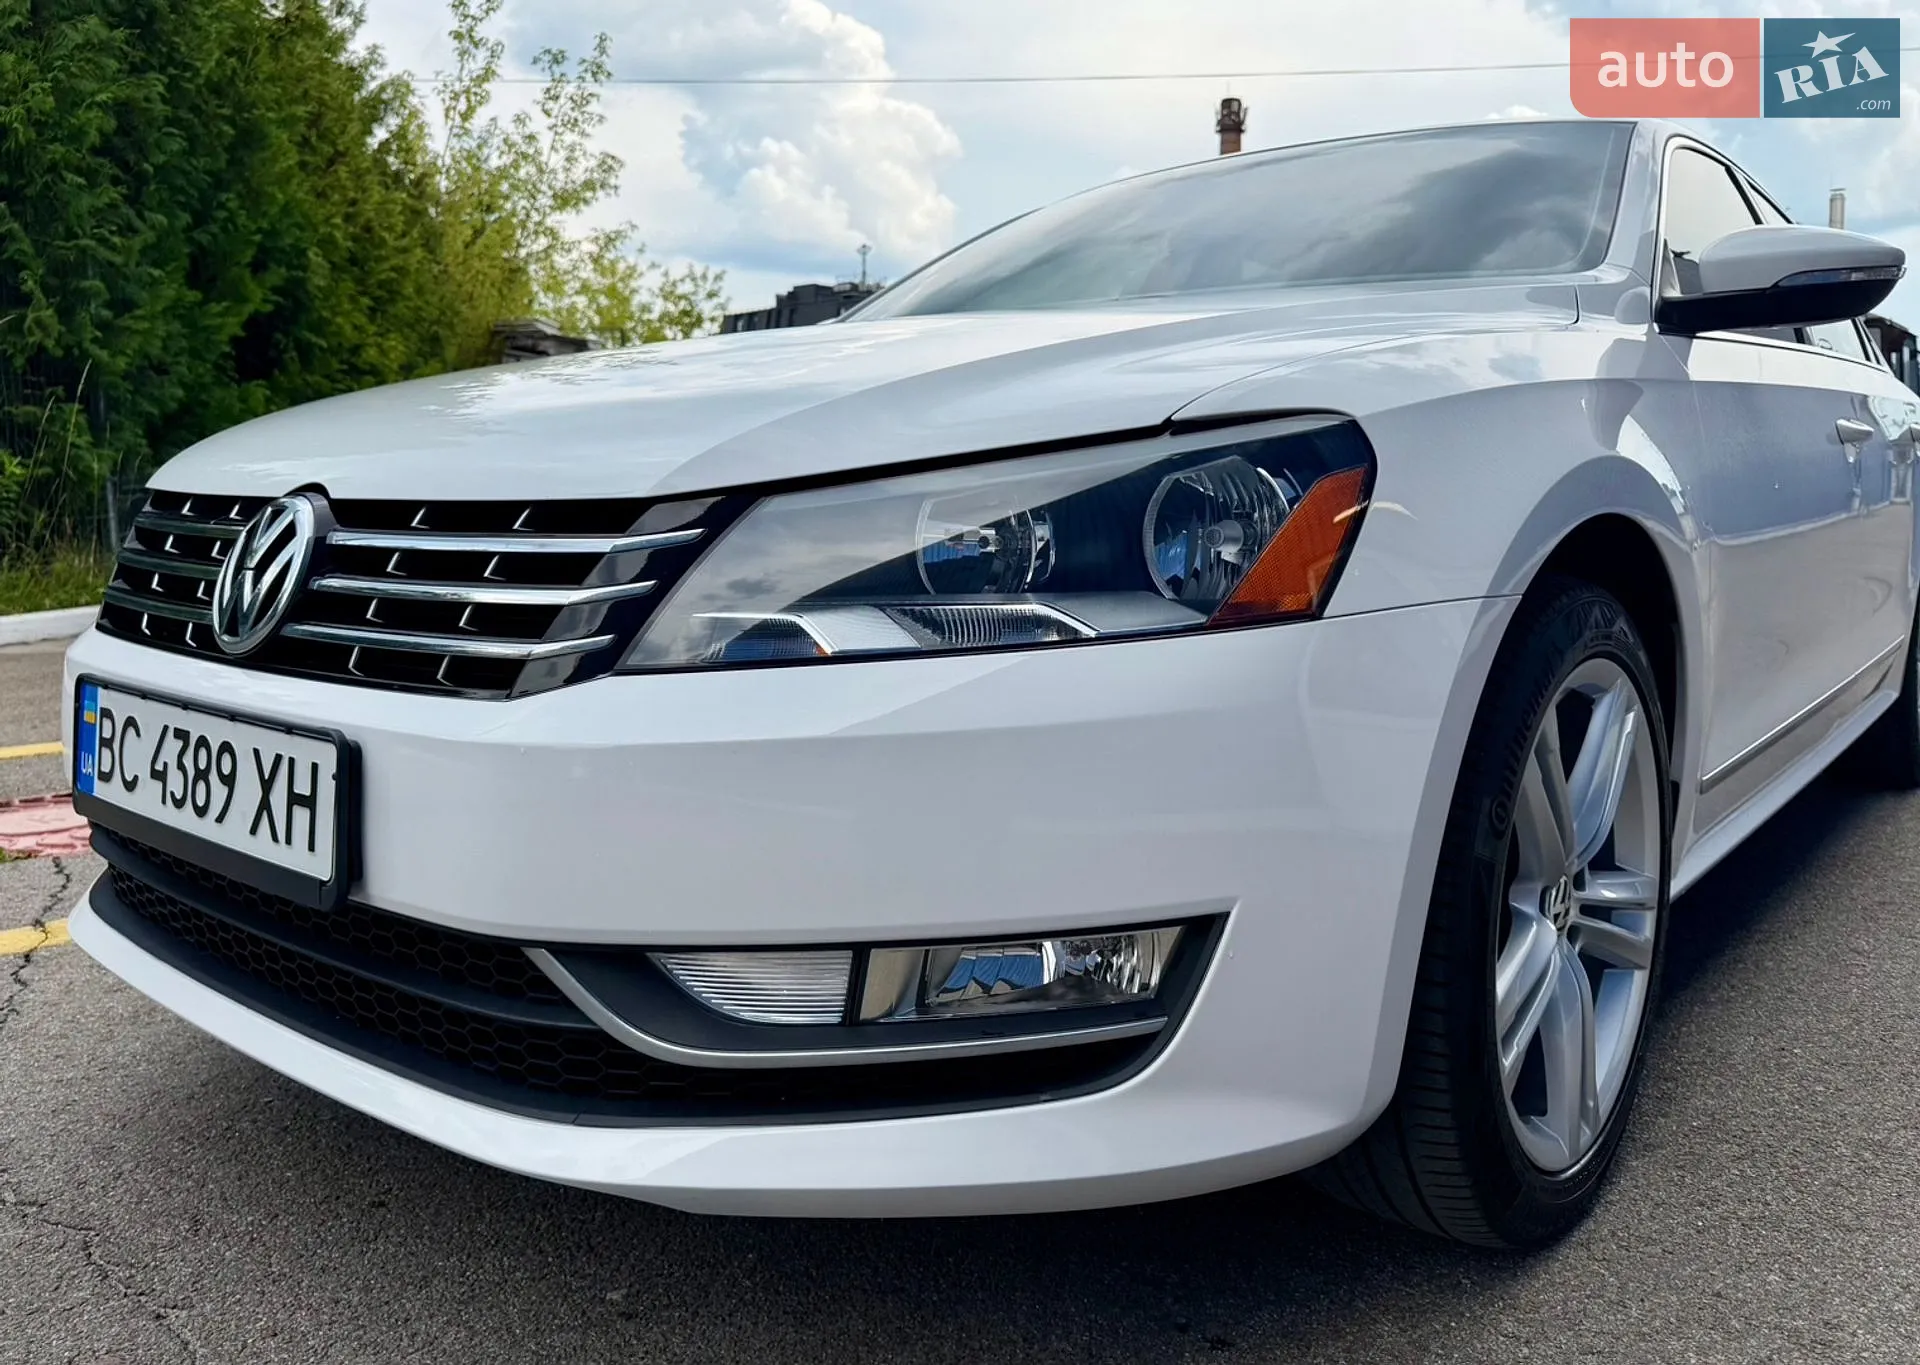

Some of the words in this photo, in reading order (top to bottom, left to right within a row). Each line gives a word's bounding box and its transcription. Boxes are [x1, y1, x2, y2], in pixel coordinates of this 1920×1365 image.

[81, 751, 94, 776] UA
[98, 706, 141, 792] BC
[150, 724, 238, 823] 4389
[249, 747, 319, 852] XH
